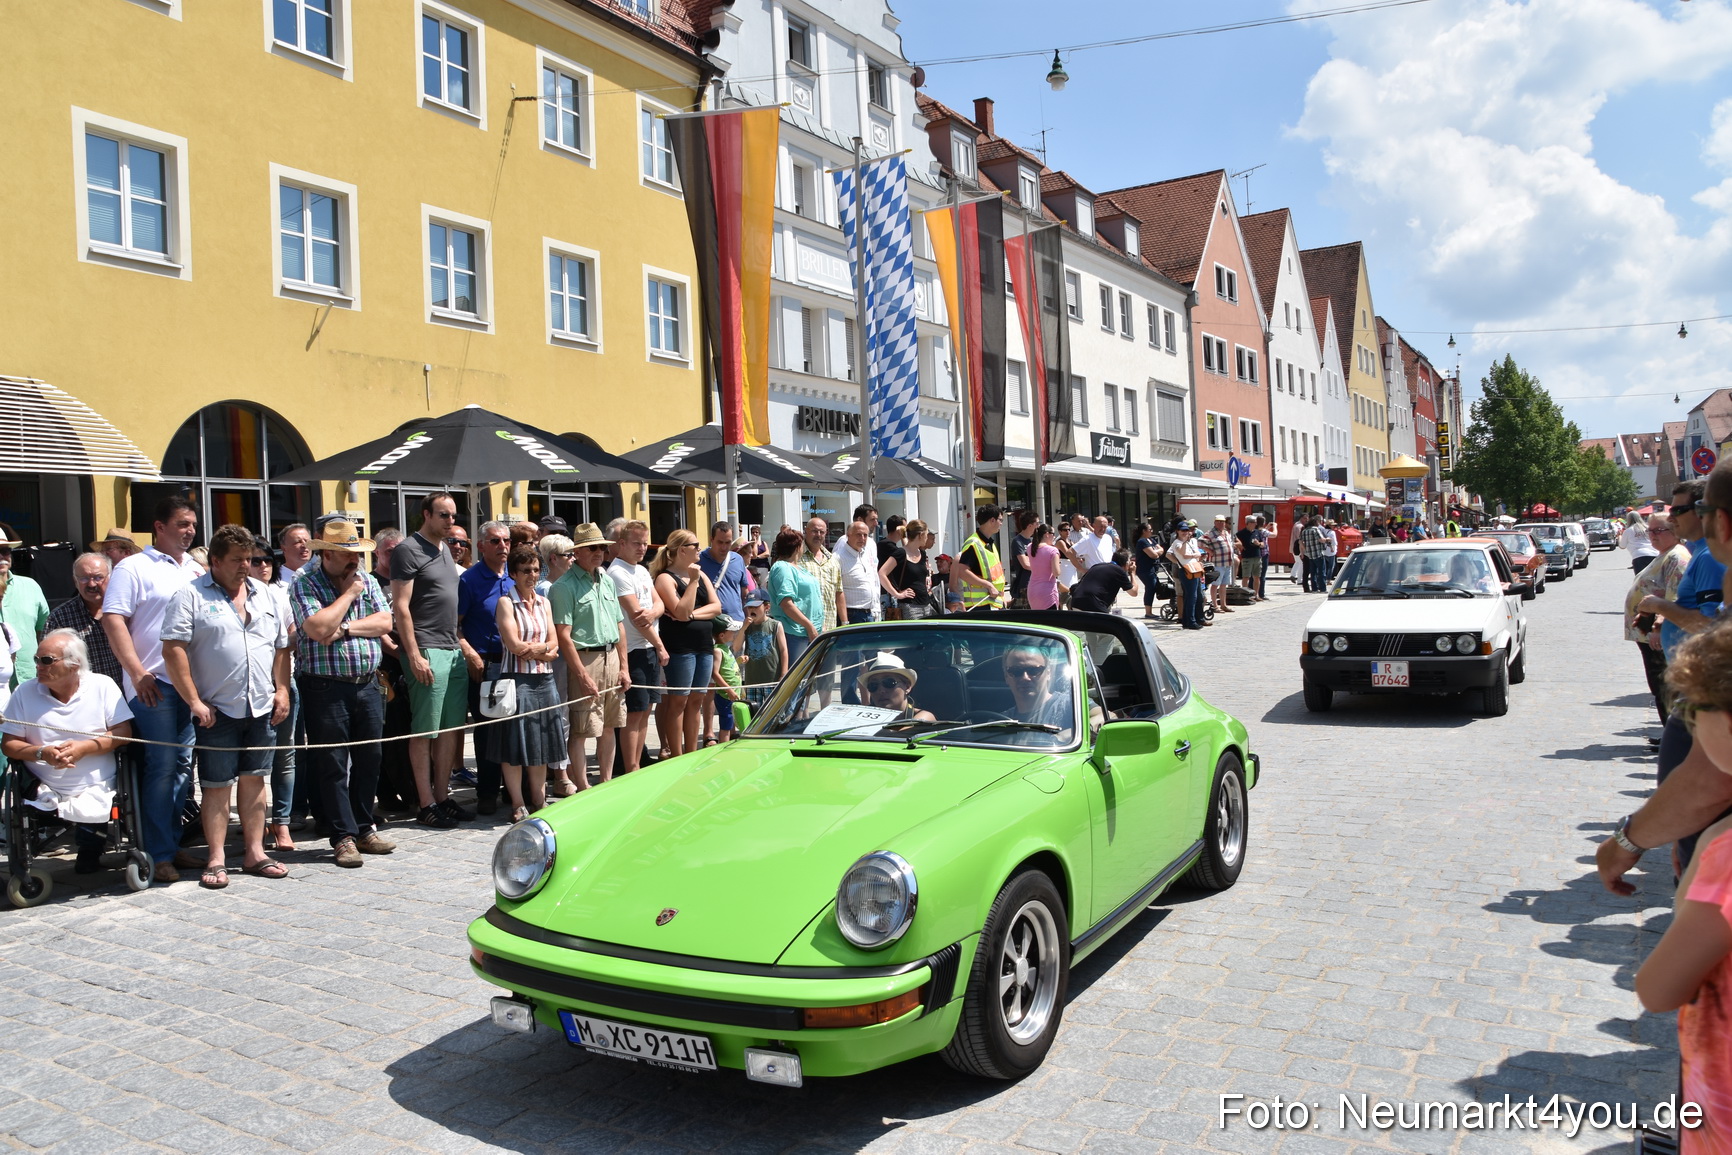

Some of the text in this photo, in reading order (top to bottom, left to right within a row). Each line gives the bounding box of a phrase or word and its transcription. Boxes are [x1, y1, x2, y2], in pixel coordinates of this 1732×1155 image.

[801, 249, 850, 283] BRILLEN
[360, 432, 433, 470] now
[495, 431, 575, 470] now
[697, 497, 706, 507] 24
[1373, 675, 1408, 685] 07642
[1384, 664, 1392, 674] R
[856, 711, 881, 720] 133
[575, 1018, 714, 1065] M XC 911H
